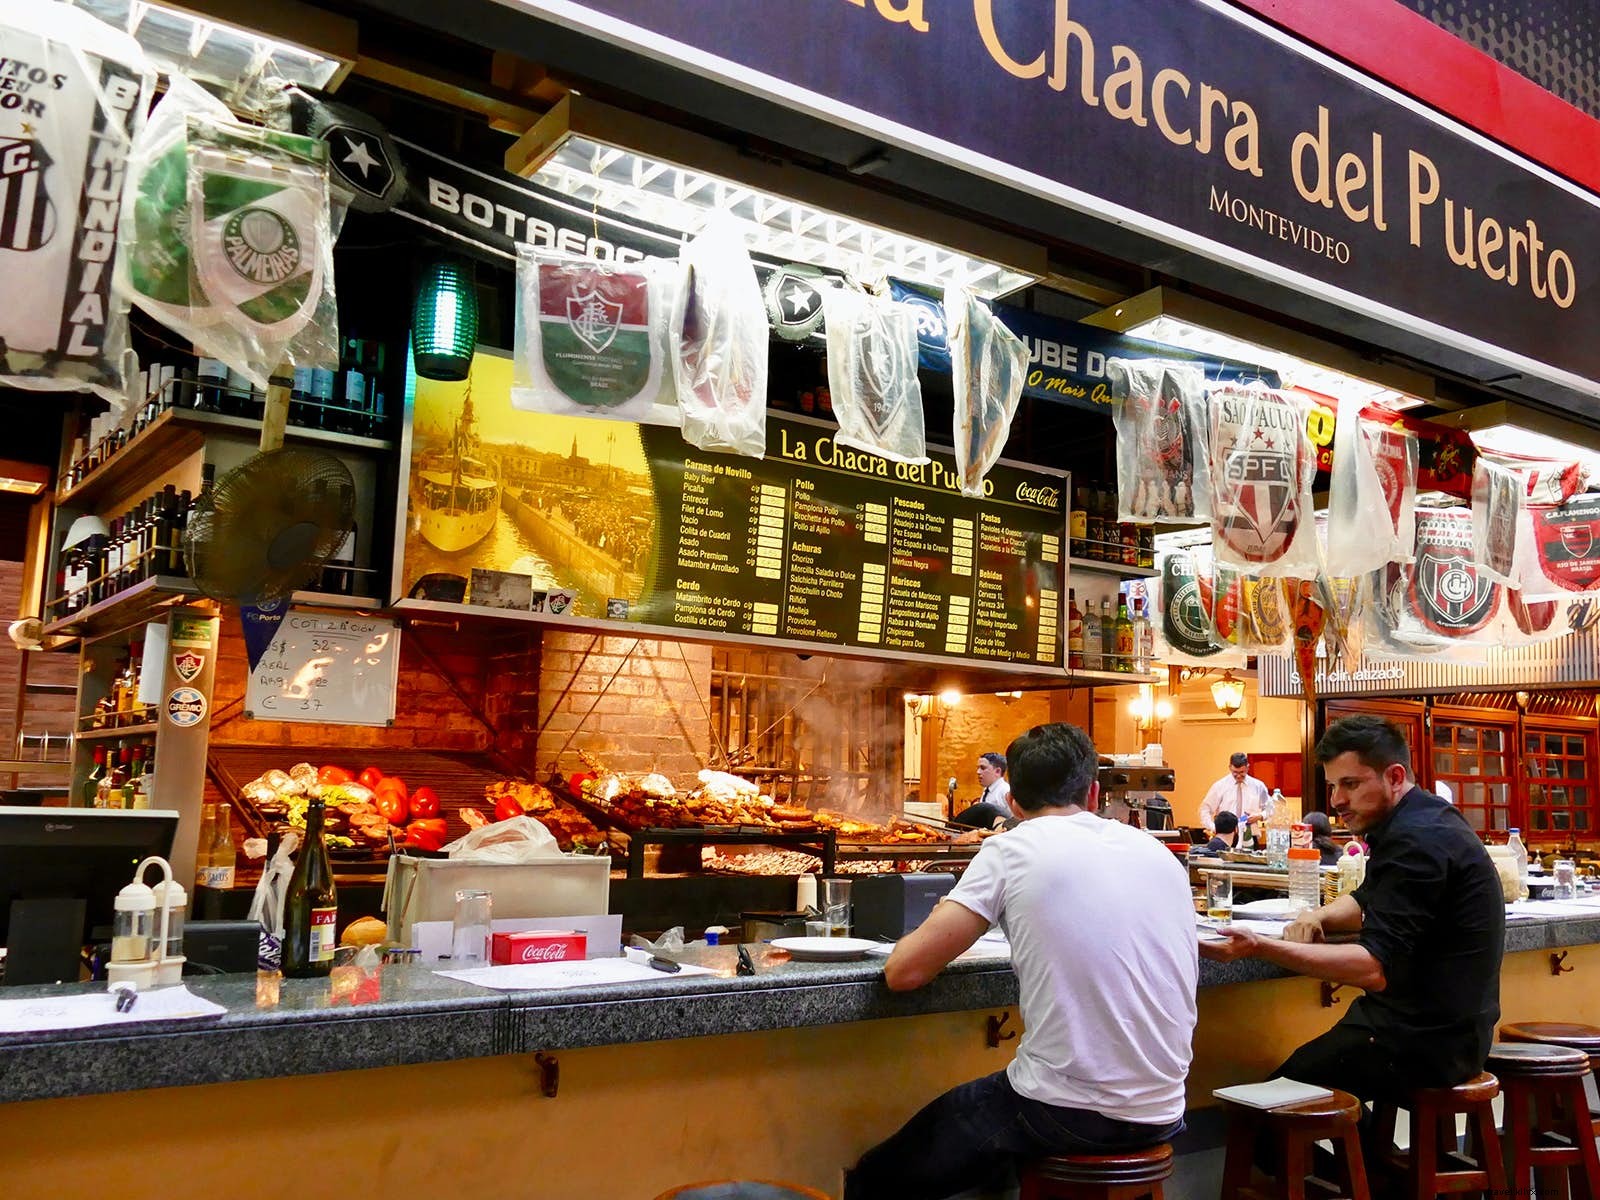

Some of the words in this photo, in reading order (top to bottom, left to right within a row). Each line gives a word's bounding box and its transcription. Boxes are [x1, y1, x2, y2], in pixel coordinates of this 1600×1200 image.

[0, 76, 32, 93] EU
[0, 91, 46, 118] OR
[973, 0, 1263, 178] Chacra
[1291, 105, 1388, 232] del
[1407, 148, 1577, 310] Puerto
[225, 235, 299, 281] PALMEIRAS
[1045, 377, 1087, 398] Mais
[781, 429, 807, 460] La
[814, 437, 888, 476] Chacra
[685, 459, 712, 472] Carnes
[726, 466, 752, 479] Novillo
[684, 472, 700, 483] Baby
[702, 474, 715, 484] Beef
[796, 479, 814, 490] Pollo
[796, 491, 810, 500] Pollo
[1016, 482, 1060, 507] Coca-Cola
[795, 502, 823, 513] Pamplona
[825, 506, 838, 515] Pollo
[895, 497, 925, 510] Pescados
[682, 504, 695, 513] Filet
[706, 508, 723, 518] Lomo
[831, 517, 845, 526] Pollo
[926, 514, 945, 523] Plancha
[981, 513, 1000, 523] Pastas
[794, 522, 808, 531] Pollo
[926, 524, 941, 533] Crema
[709, 530, 731, 540] Cuadril
[894, 528, 902, 536] Pez
[904, 531, 922, 539] Espada
[680, 537, 699, 546] Asado
[893, 538, 902, 546] Pez
[904, 540, 922, 549] Espada
[933, 544, 949, 553] Crema
[792, 542, 822, 554] Achuras
[679, 548, 698, 557] Asado
[700, 550, 728, 561] Premium
[792, 554, 813, 564] Chorizo
[678, 558, 710, 570] Matambre
[711, 563, 739, 573] Arrollado
[914, 560, 928, 569] Negra
[791, 565, 814, 575] Morcilla
[840, 571, 856, 580] Dulce
[980, 570, 1002, 580] Bebidas
[677, 579, 700, 590] Cerdo
[891, 576, 920, 587] Mariscos
[676, 592, 712, 604] Matambrito
[723, 599, 741, 607] Cerdo
[826, 590, 843, 598] Choto
[919, 592, 941, 601] Mariscos
[890, 598, 904, 606] Arroz
[916, 601, 938, 610] Mariscos
[676, 604, 706, 615] Pamplona
[718, 608, 735, 617] Cerdo
[675, 614, 698, 625] Costilla
[709, 618, 726, 627] Cerdo
[915, 621, 936, 629] Romana
[995, 630, 1006, 638] Vino
[902, 639, 913, 647] para
[915, 640, 924, 648] Dos
[975, 638, 986, 646] Copa
[522, 943, 568, 961] Coca-Cola
